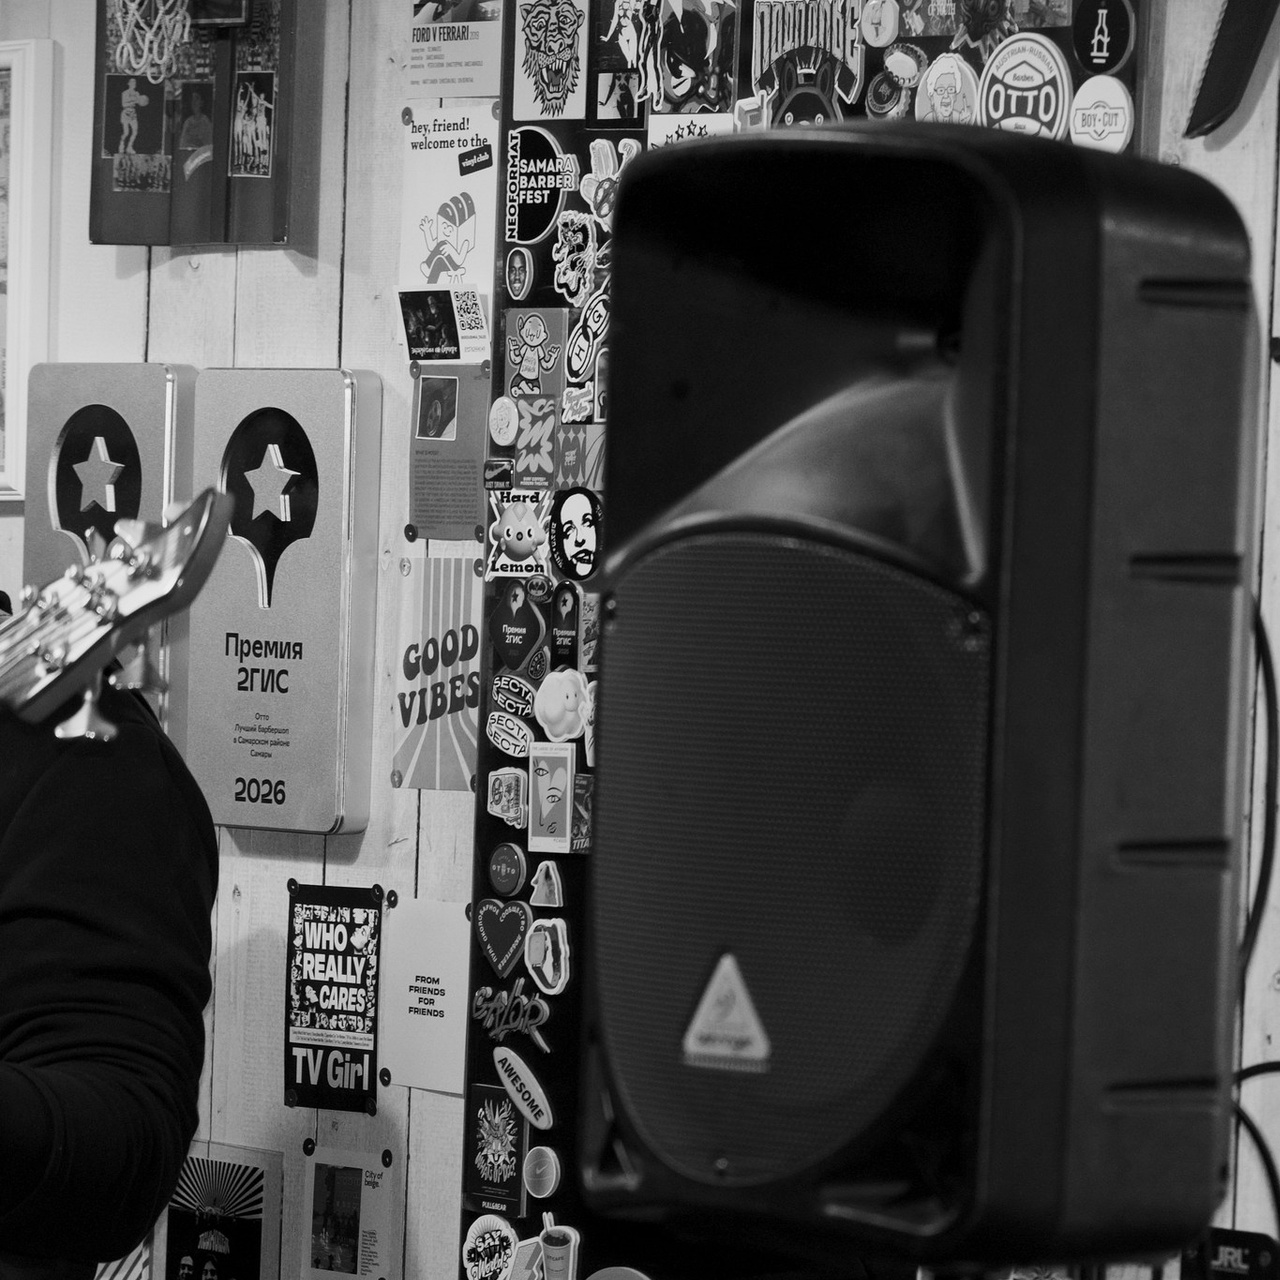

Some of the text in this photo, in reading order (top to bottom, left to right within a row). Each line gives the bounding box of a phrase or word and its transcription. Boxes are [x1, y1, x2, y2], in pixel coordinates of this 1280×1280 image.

[412, 27, 431, 42] FORD
[432, 26, 438, 41] V
[439, 25, 470, 41] FERRARI
[988, 83, 1056, 123] OTTO
[411, 118, 470, 136] hey, friend!
[411, 136, 488, 150] welcome to the
[520, 159, 573, 173] SAMARA
[506, 132, 520, 239] NEOFORMAT
[520, 175, 573, 189] BARBER
[520, 190, 550, 204] FEST
[500, 492, 540, 503] Hard
[490, 561, 545, 573] Lemon
[502, 625, 527, 634] Премия
[553, 628, 576, 637] Премия
[225, 632, 303, 663] Премия
[505, 635, 523, 644] 2ГИС
[556, 637, 572, 646] 2ГИС
[403, 624, 479, 681] GOOD
[237, 667, 289, 694] 2ГИС
[493, 676, 534, 703] SECTA
[398, 671, 480, 728] VIBES
[492, 690, 532, 717] SECTA
[255, 712, 269, 720] Отто
[234, 723, 290, 734] Лучший барбершоп
[489, 713, 529, 741] SECTA
[487, 727, 526, 756] SECTA
[234, 777, 286, 805] 2026
[304, 921, 348, 952] WHO
[302, 952, 366, 984] REALLY
[415, 975, 440, 985] FROM
[319, 985, 366, 1012] CARES
[408, 985, 446, 996] FRIENDS
[418, 996, 435, 1006] FOR
[408, 1006, 445, 1018] FRIENDS
[292, 1047, 369, 1091] TV Girl
[498, 1057, 545, 1121] AWESOME
